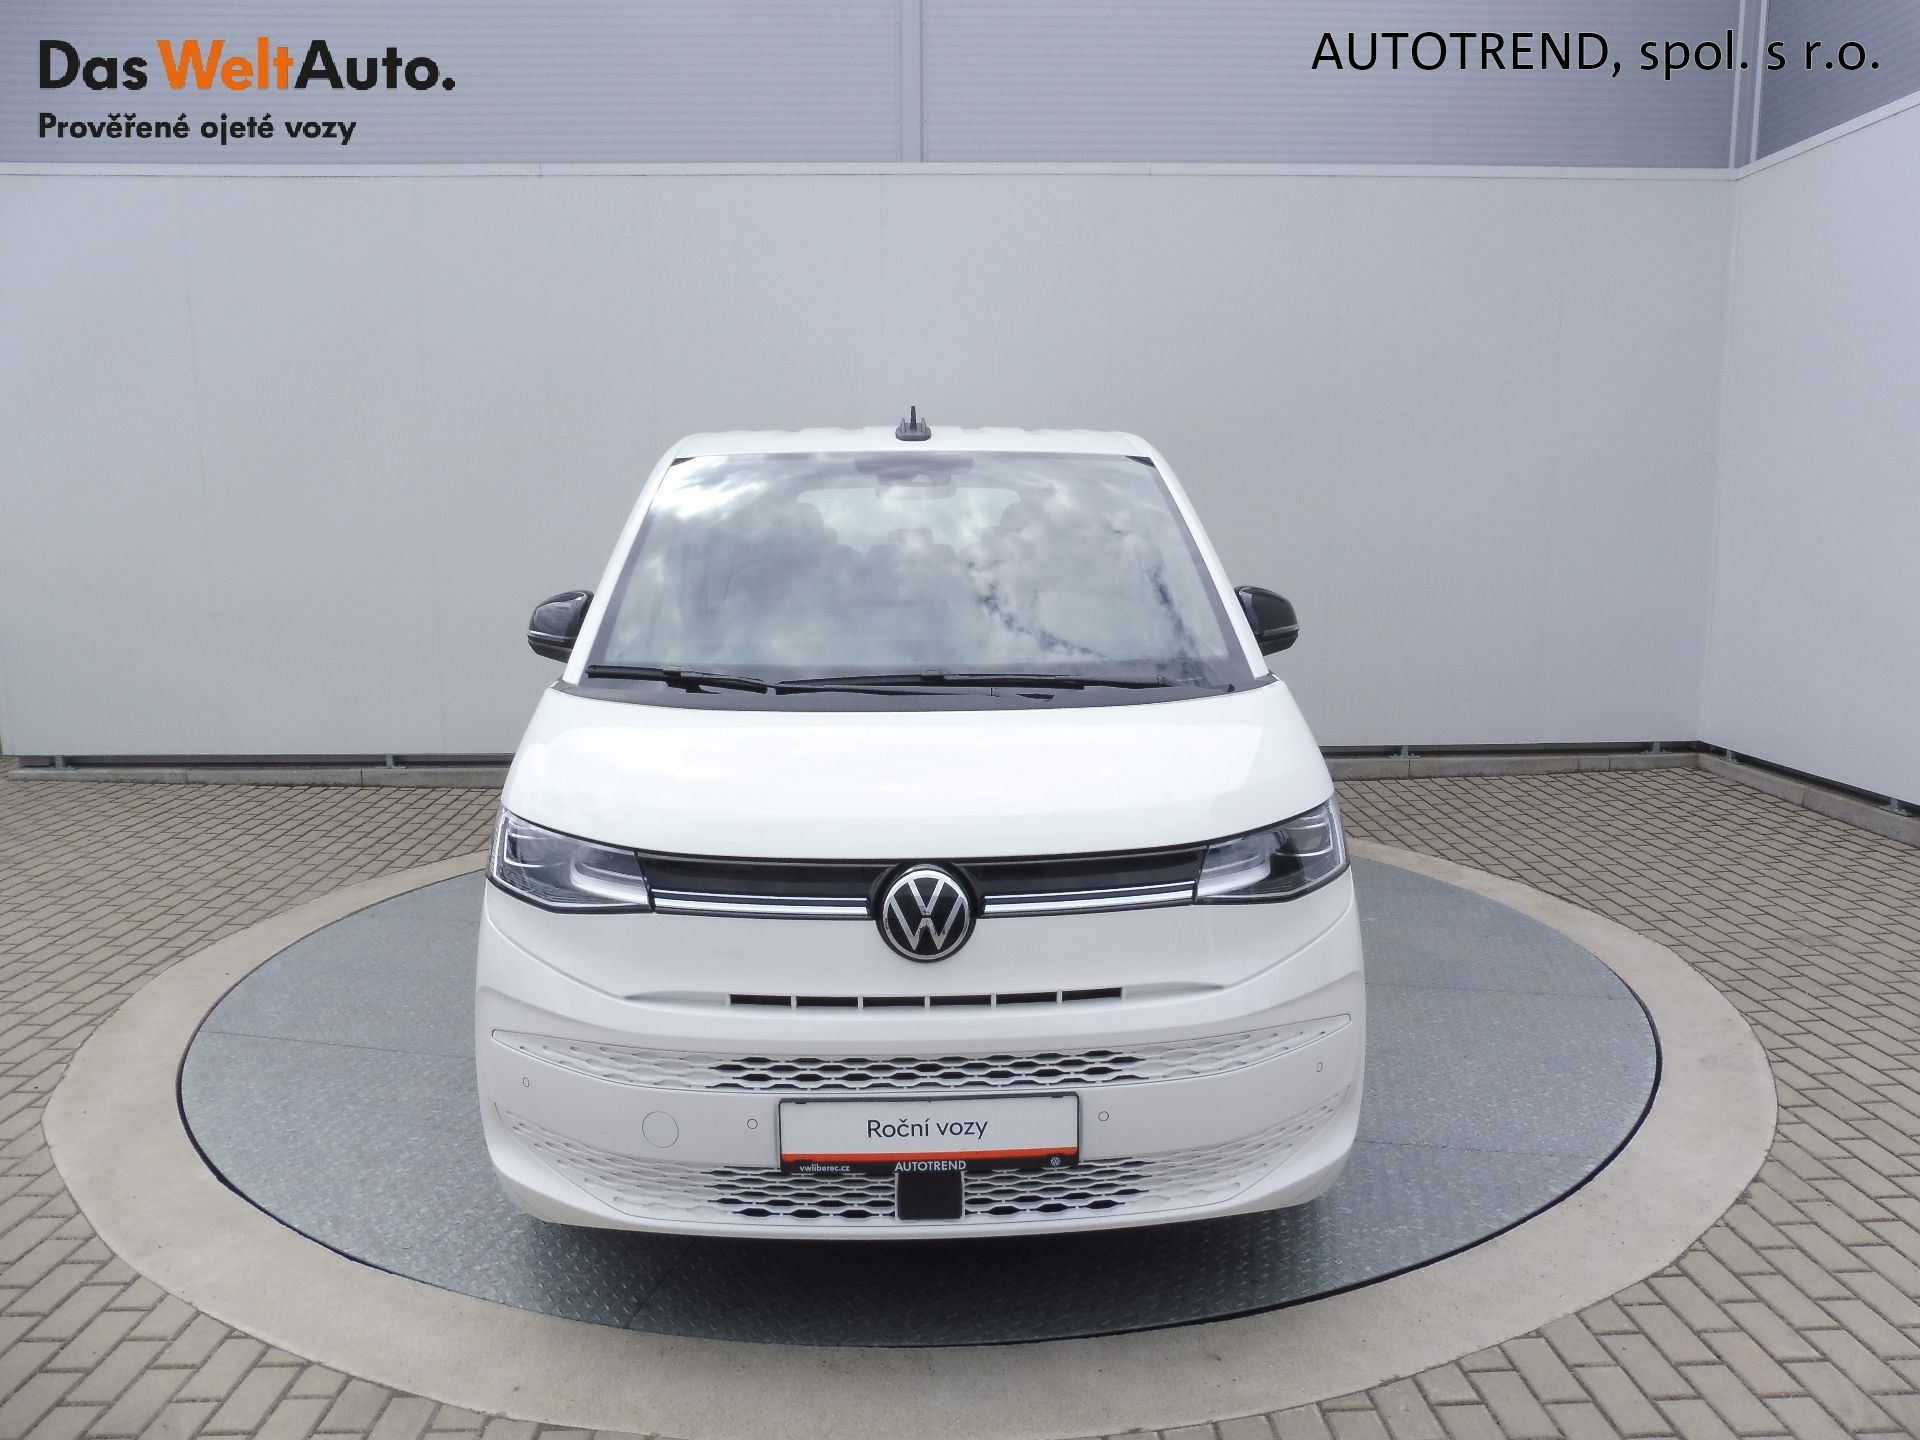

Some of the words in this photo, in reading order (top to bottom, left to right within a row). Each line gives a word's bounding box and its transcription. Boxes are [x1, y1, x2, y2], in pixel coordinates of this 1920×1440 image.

[867, 1118, 930, 1139] Roční
[936, 1119, 989, 1140] vozy
[799, 1163, 850, 1172] vwliberec.cz
[894, 1160, 967, 1172] AUTOTREND
